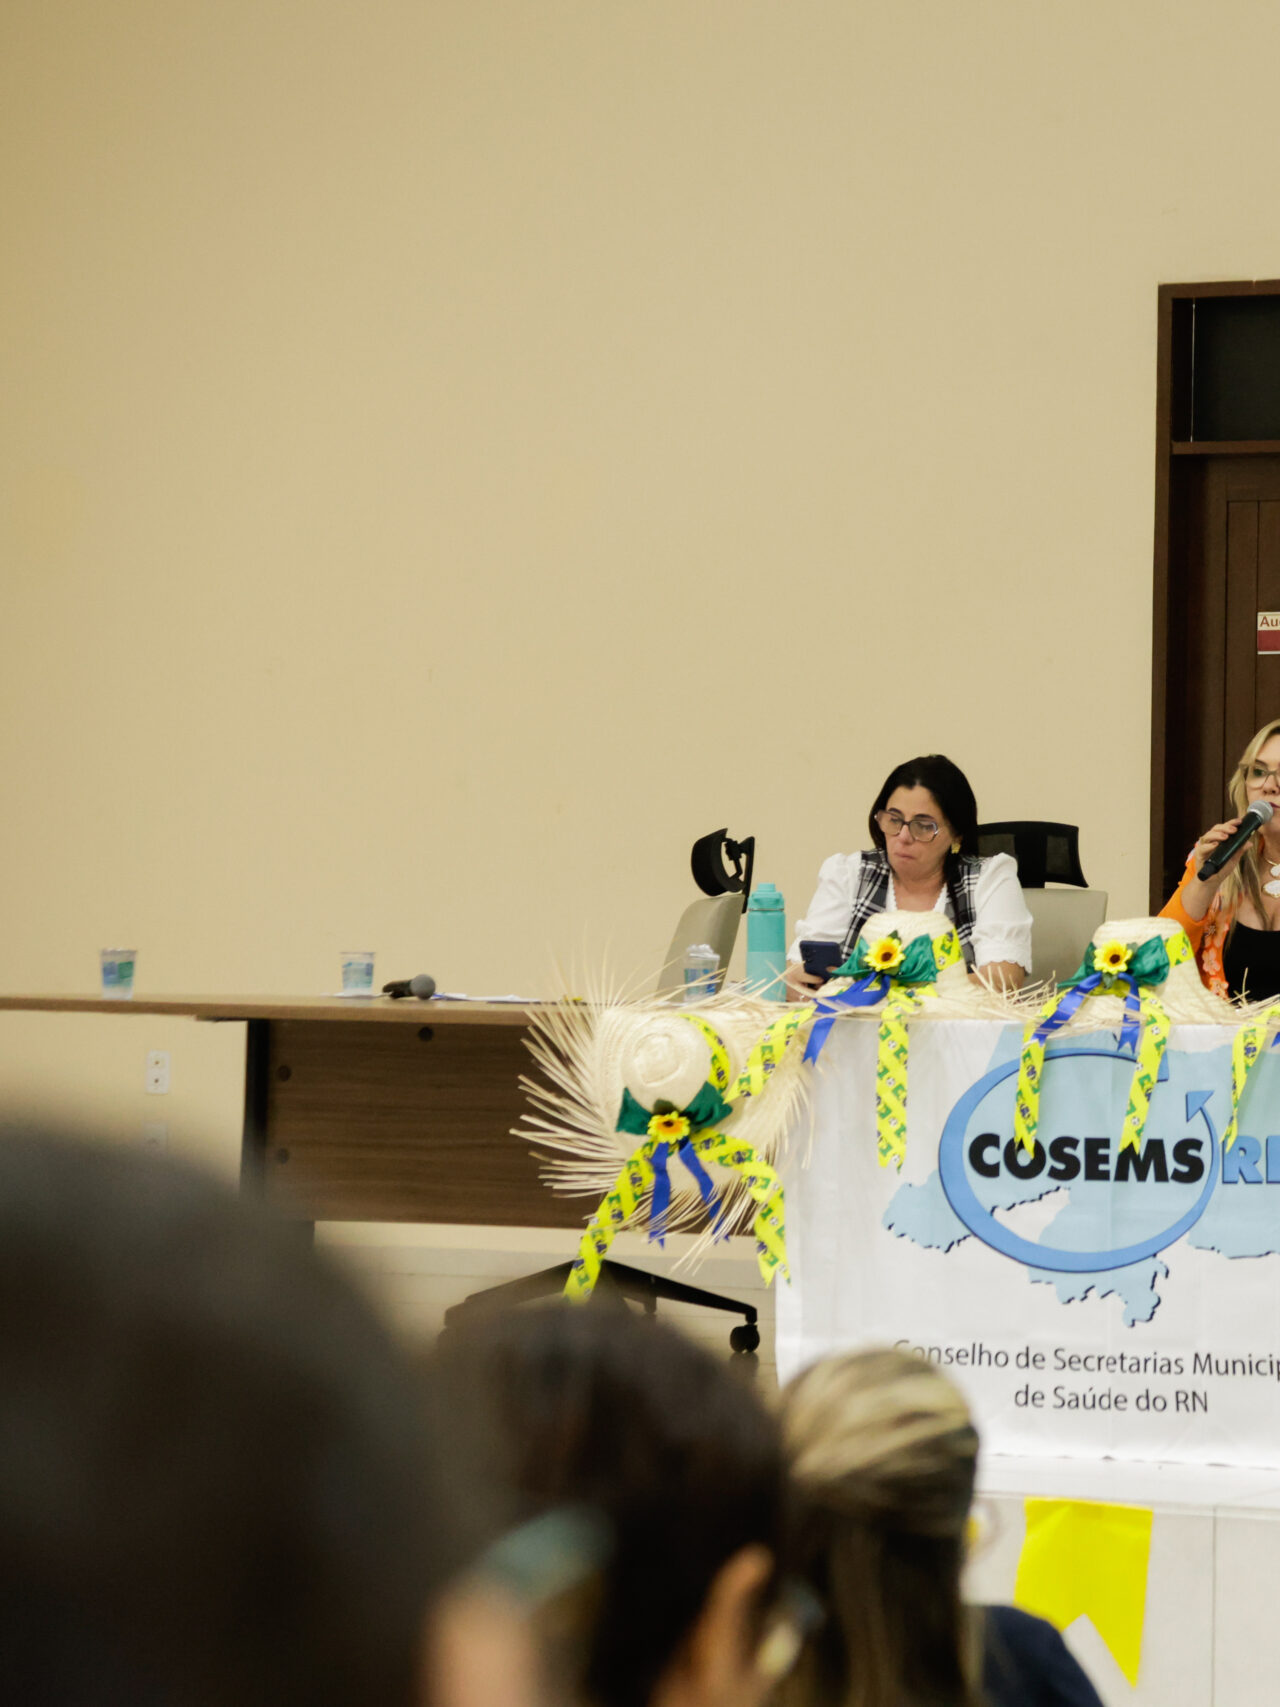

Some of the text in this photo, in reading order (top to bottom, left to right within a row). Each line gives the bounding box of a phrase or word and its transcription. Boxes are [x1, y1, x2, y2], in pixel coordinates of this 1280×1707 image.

[968, 1133, 1205, 1184] COSEMS
[1015, 1346, 1046, 1369] de
[1053, 1348, 1184, 1374] Secretarias
[1014, 1384, 1208, 1413] de Saúde do RN
